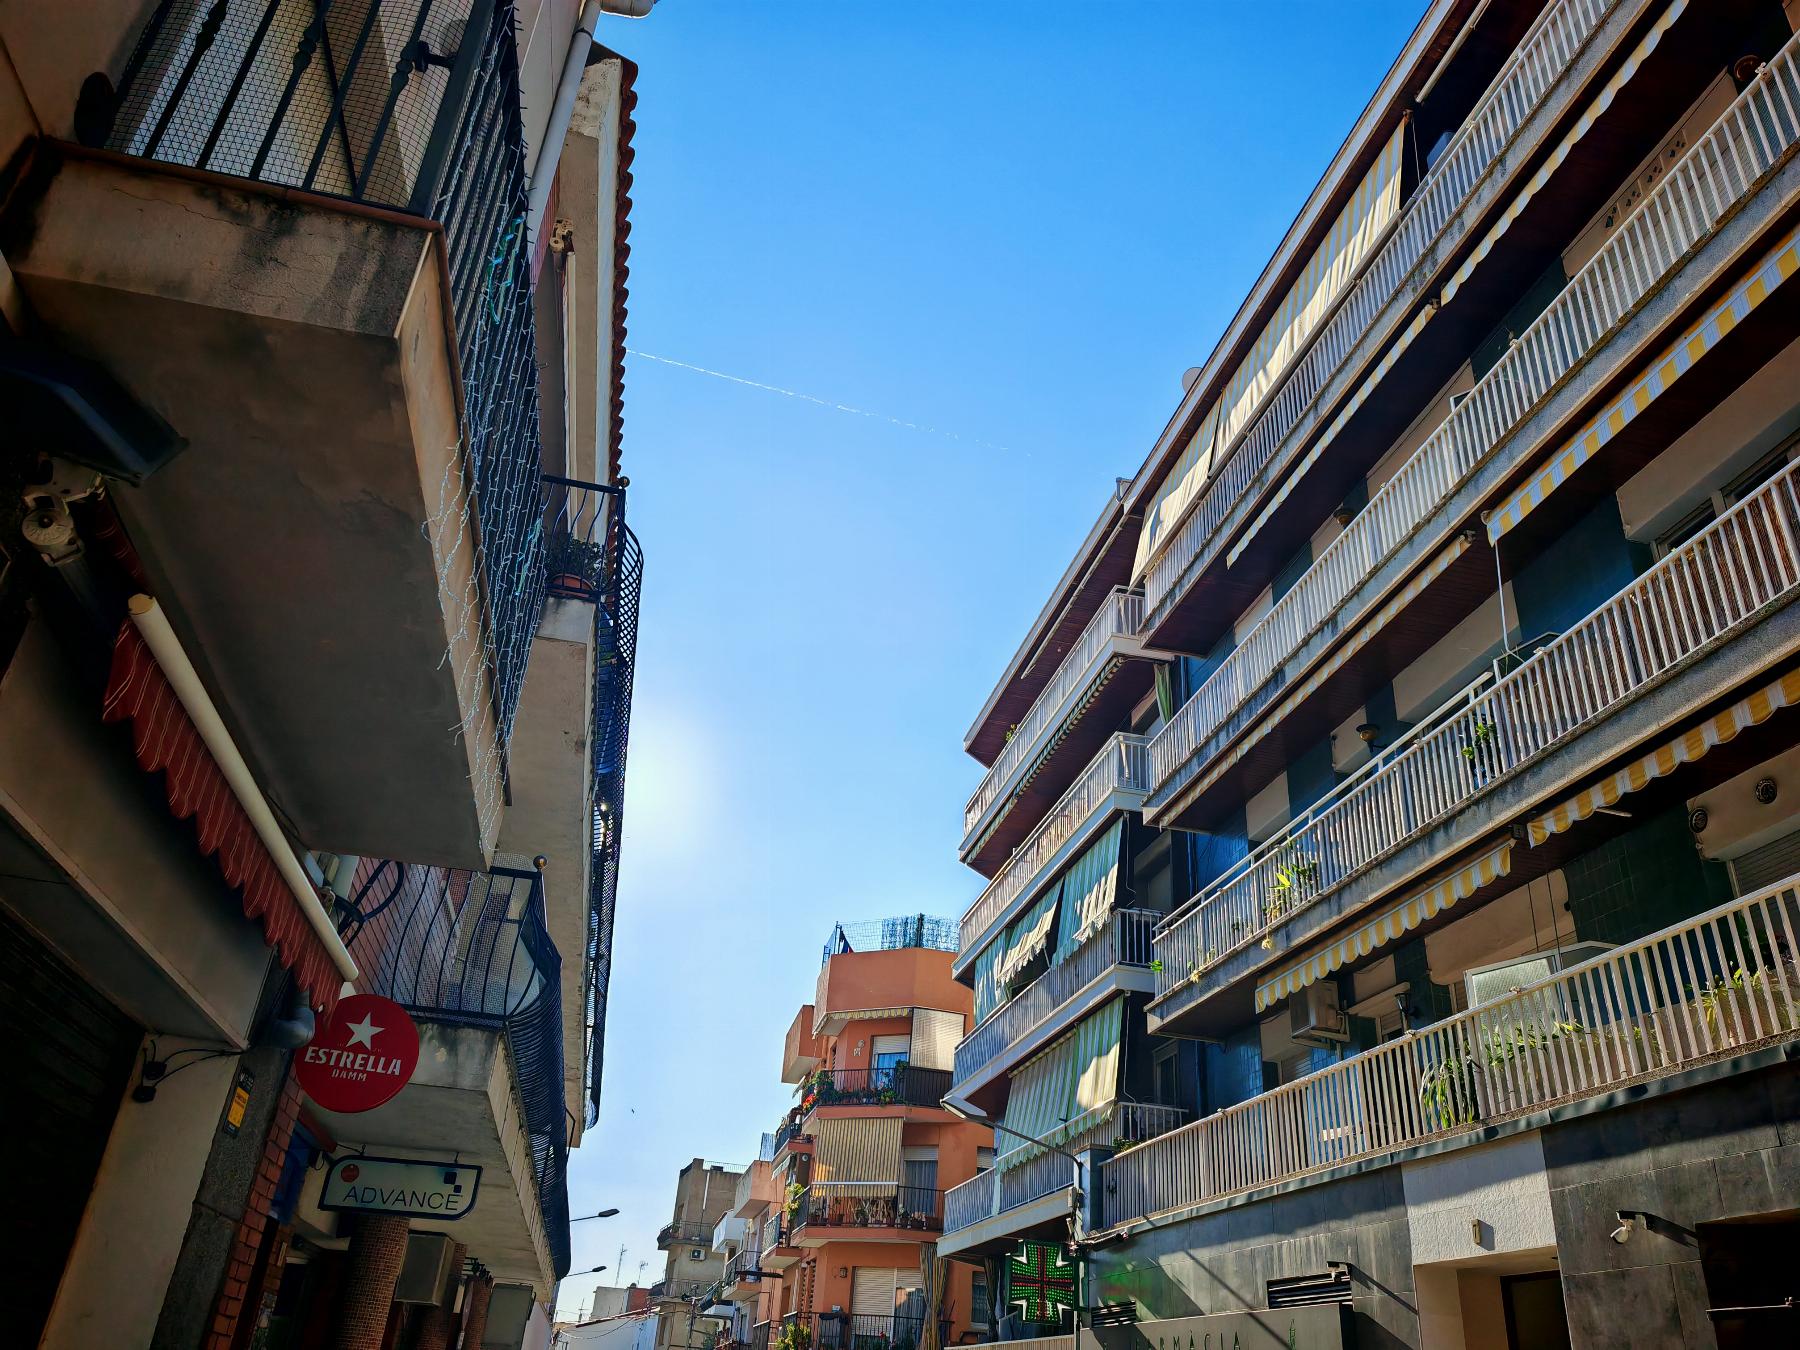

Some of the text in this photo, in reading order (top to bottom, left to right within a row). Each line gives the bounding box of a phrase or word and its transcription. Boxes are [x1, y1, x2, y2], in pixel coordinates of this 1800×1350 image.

[304, 1046, 402, 1076] ESTRELLA
[331, 1068, 369, 1082] DAMM
[343, 1185, 463, 1211] ADVANCE
